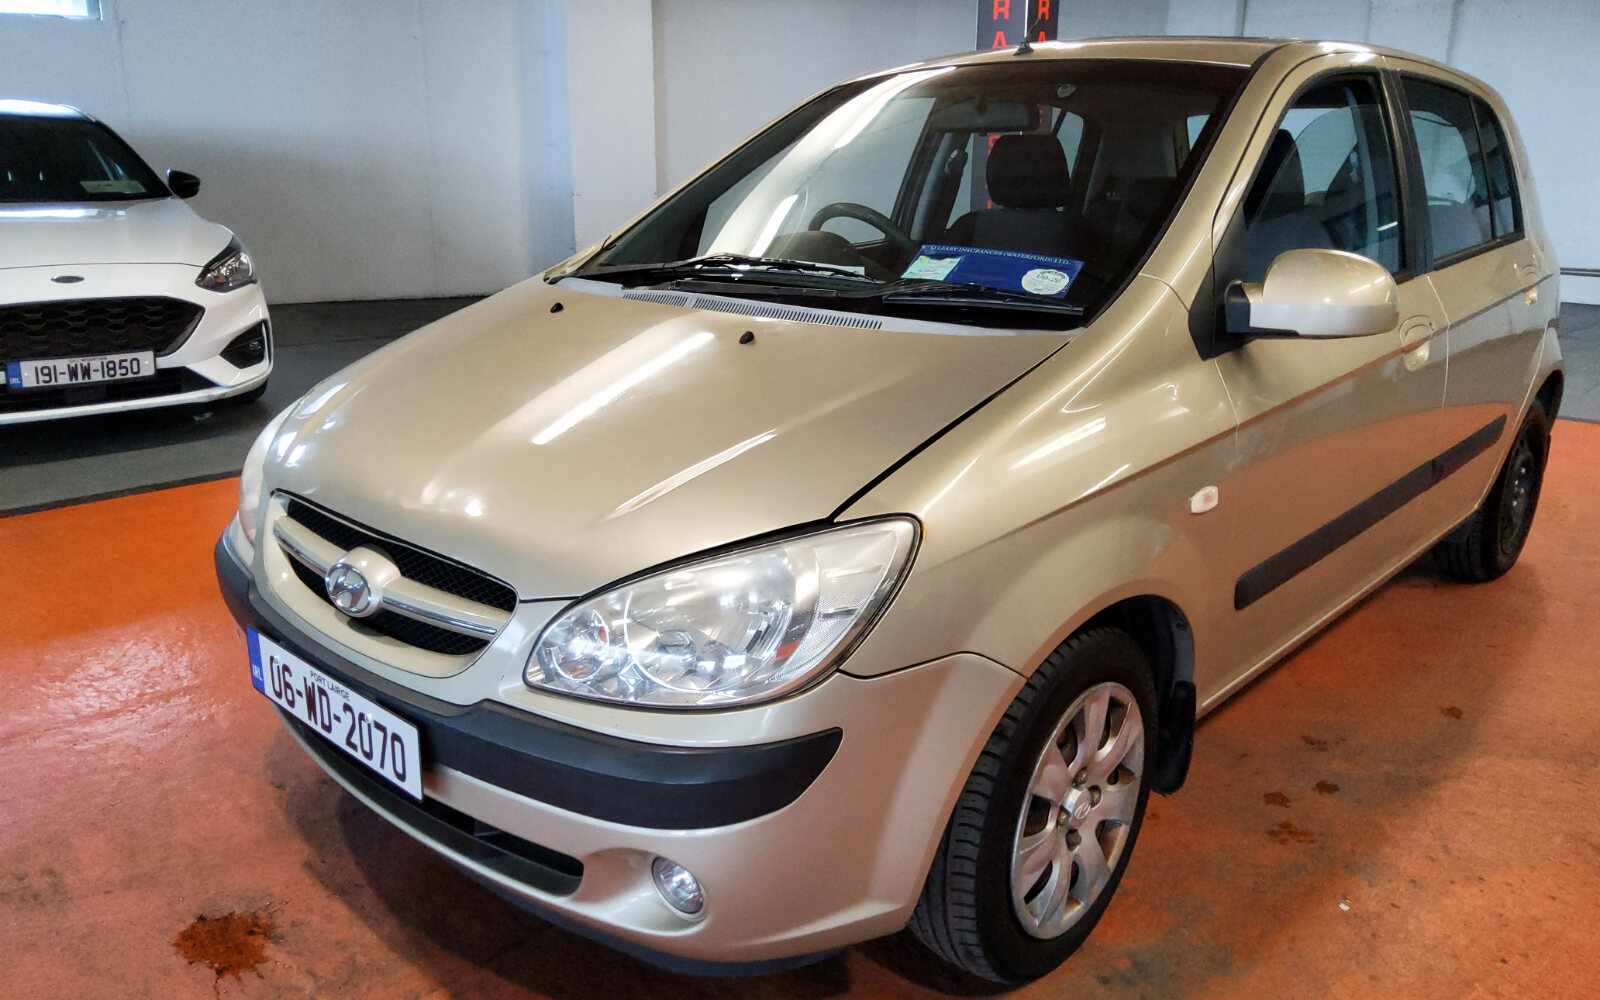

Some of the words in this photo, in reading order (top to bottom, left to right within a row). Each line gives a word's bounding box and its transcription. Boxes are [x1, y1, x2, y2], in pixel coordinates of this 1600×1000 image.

[34, 357, 141, 385] 191-WW-1850
[252, 664, 263, 681] IRL
[310, 670, 326, 686] PORT
[269, 655, 407, 783] 06-WD-2070
